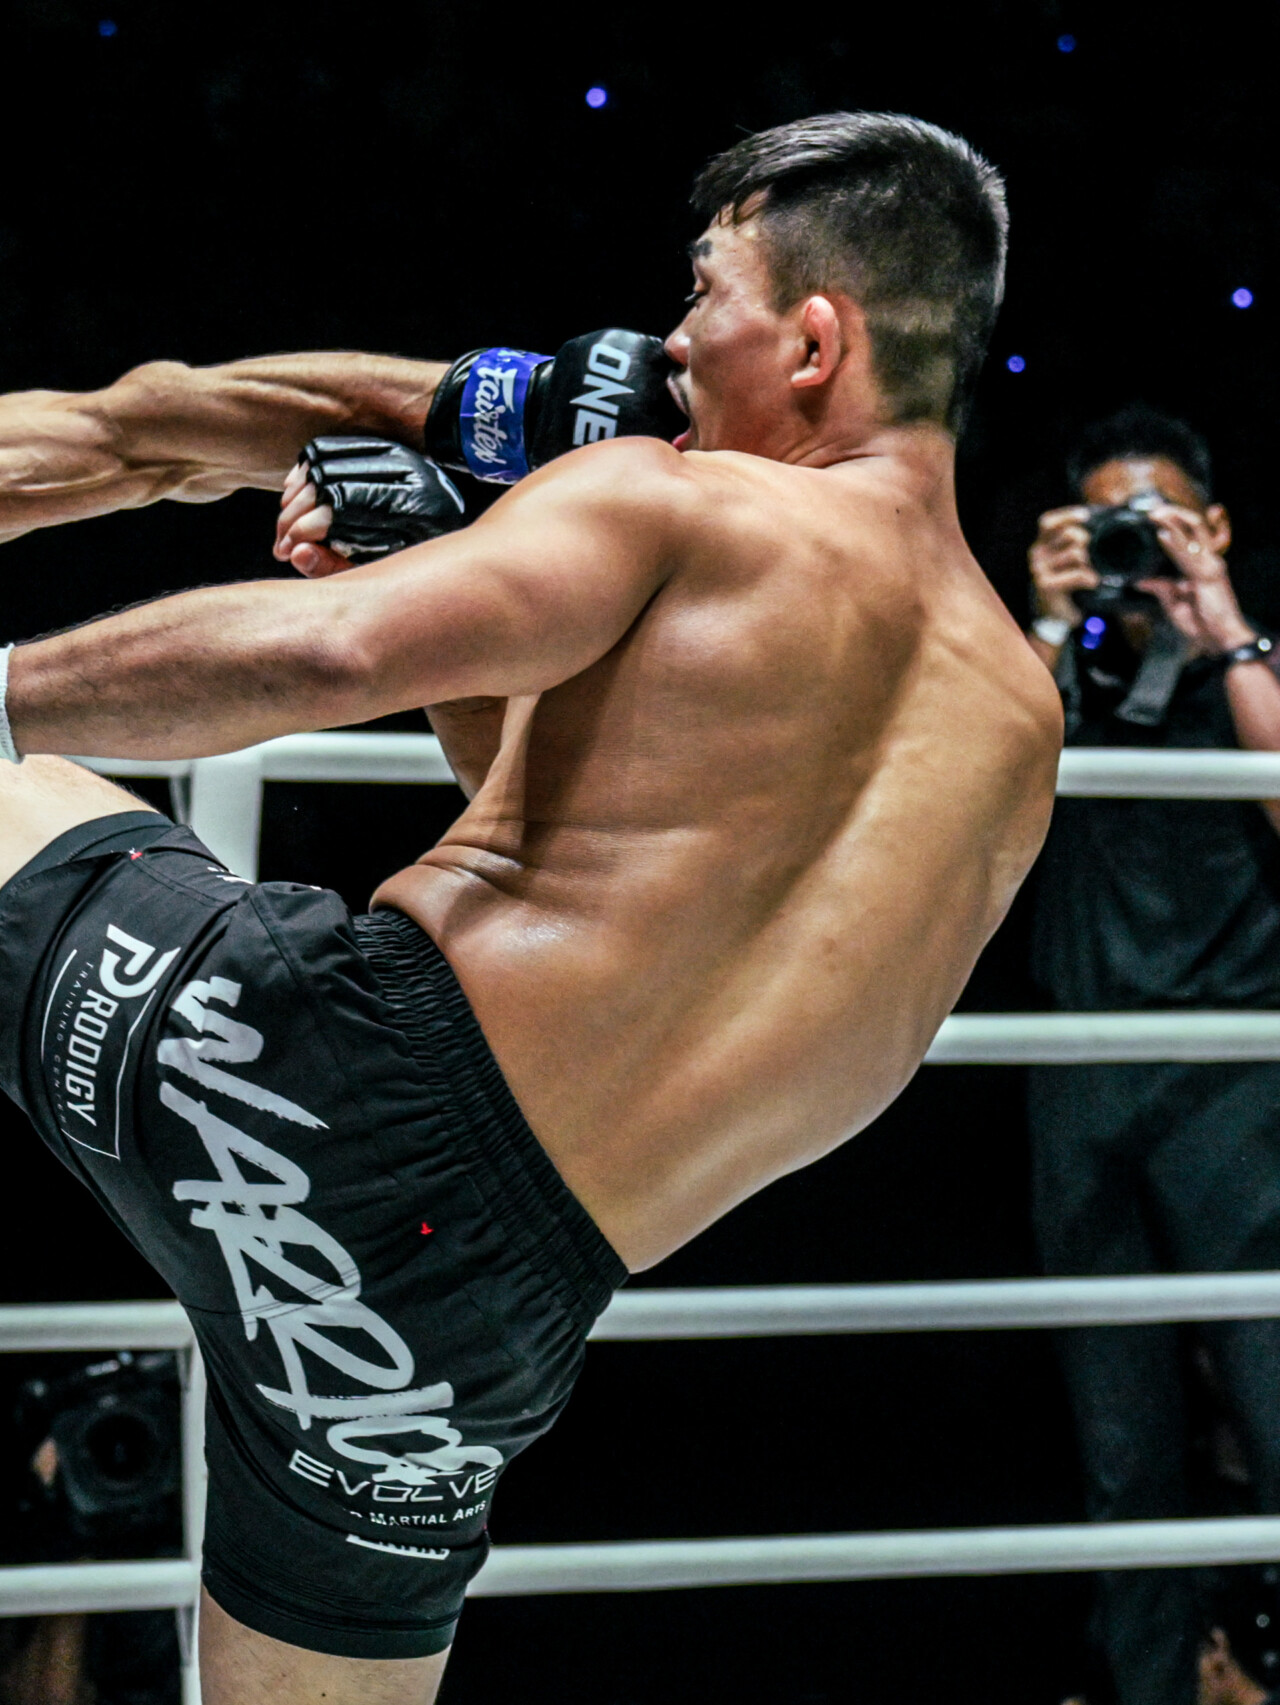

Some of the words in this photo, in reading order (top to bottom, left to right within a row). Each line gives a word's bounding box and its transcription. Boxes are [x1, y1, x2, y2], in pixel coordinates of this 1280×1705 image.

[472, 366, 518, 465] Fairtex
[570, 342, 635, 447] ONE
[64, 923, 182, 1127] PRODIGY
[288, 1449, 499, 1502] EVOLVE
[369, 1511, 448, 1527] MARTIAL
[452, 1500, 487, 1521] ARTS
